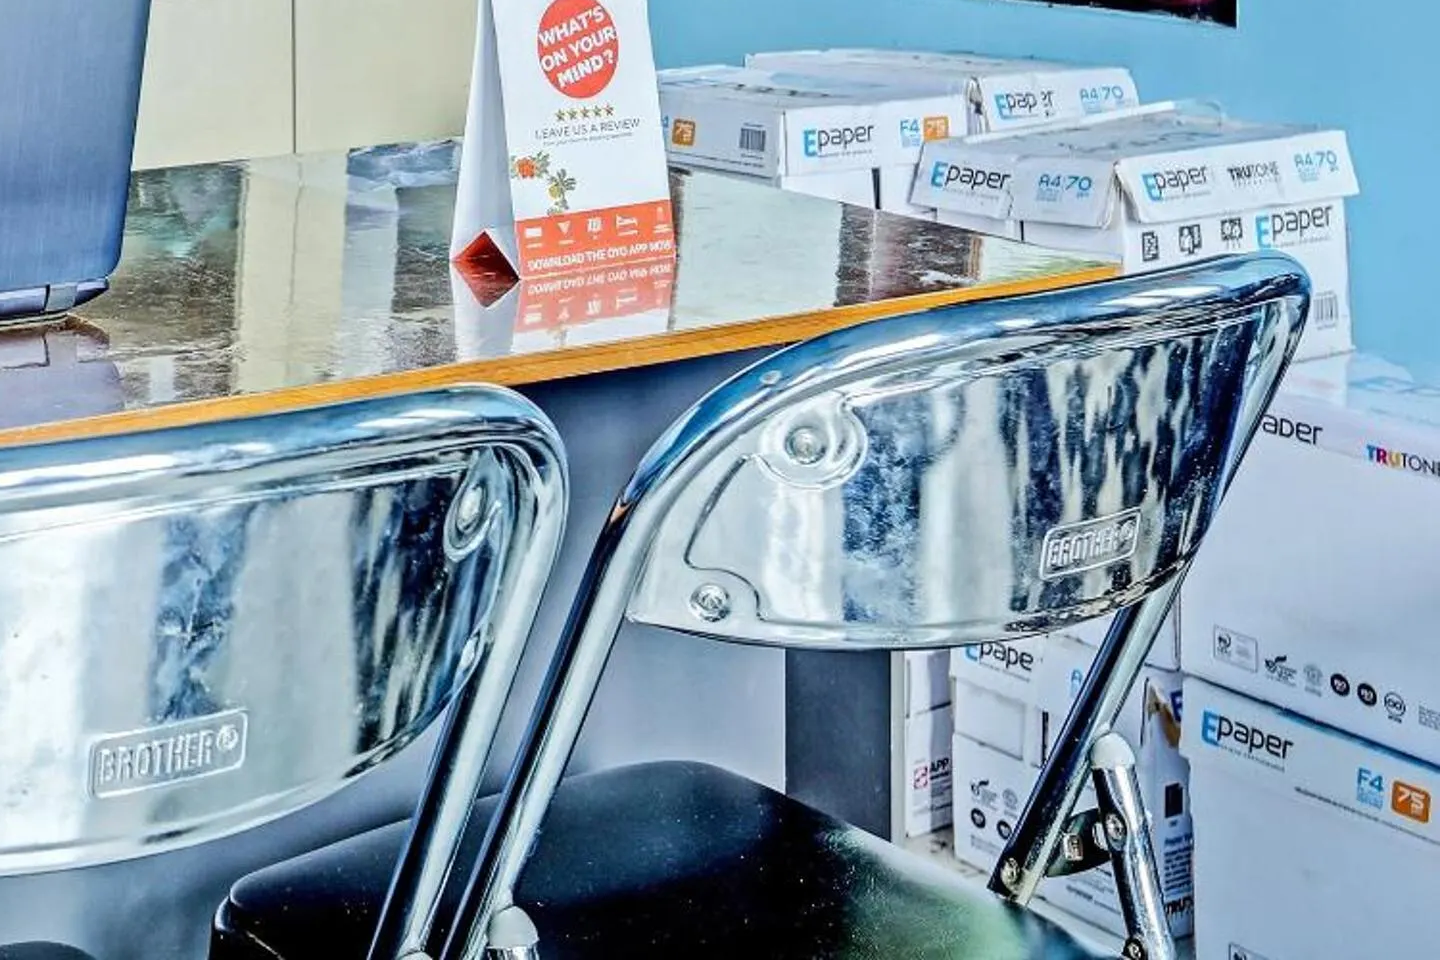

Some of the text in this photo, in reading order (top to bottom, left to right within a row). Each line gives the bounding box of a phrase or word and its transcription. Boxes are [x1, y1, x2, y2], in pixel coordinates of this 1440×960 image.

[539, 5, 606, 47] WHAT'S
[541, 26, 617, 72] ON YOUR
[535, 118, 640, 139] LEAVE US A REVIEW
[803, 124, 874, 158] Epaper
[930, 161, 1011, 189] Epaper
[1142, 165, 1207, 201] Epaper
[1255, 205, 1333, 250] Epaper
[527, 252, 585, 271] DOWNLOAD
[586, 249, 607, 262] THE
[1201, 710, 1293, 760] Epaper
[99, 729, 214, 786] BROTHER
[1357, 767, 1384, 793] F4
[1396, 786, 1425, 810] 75
